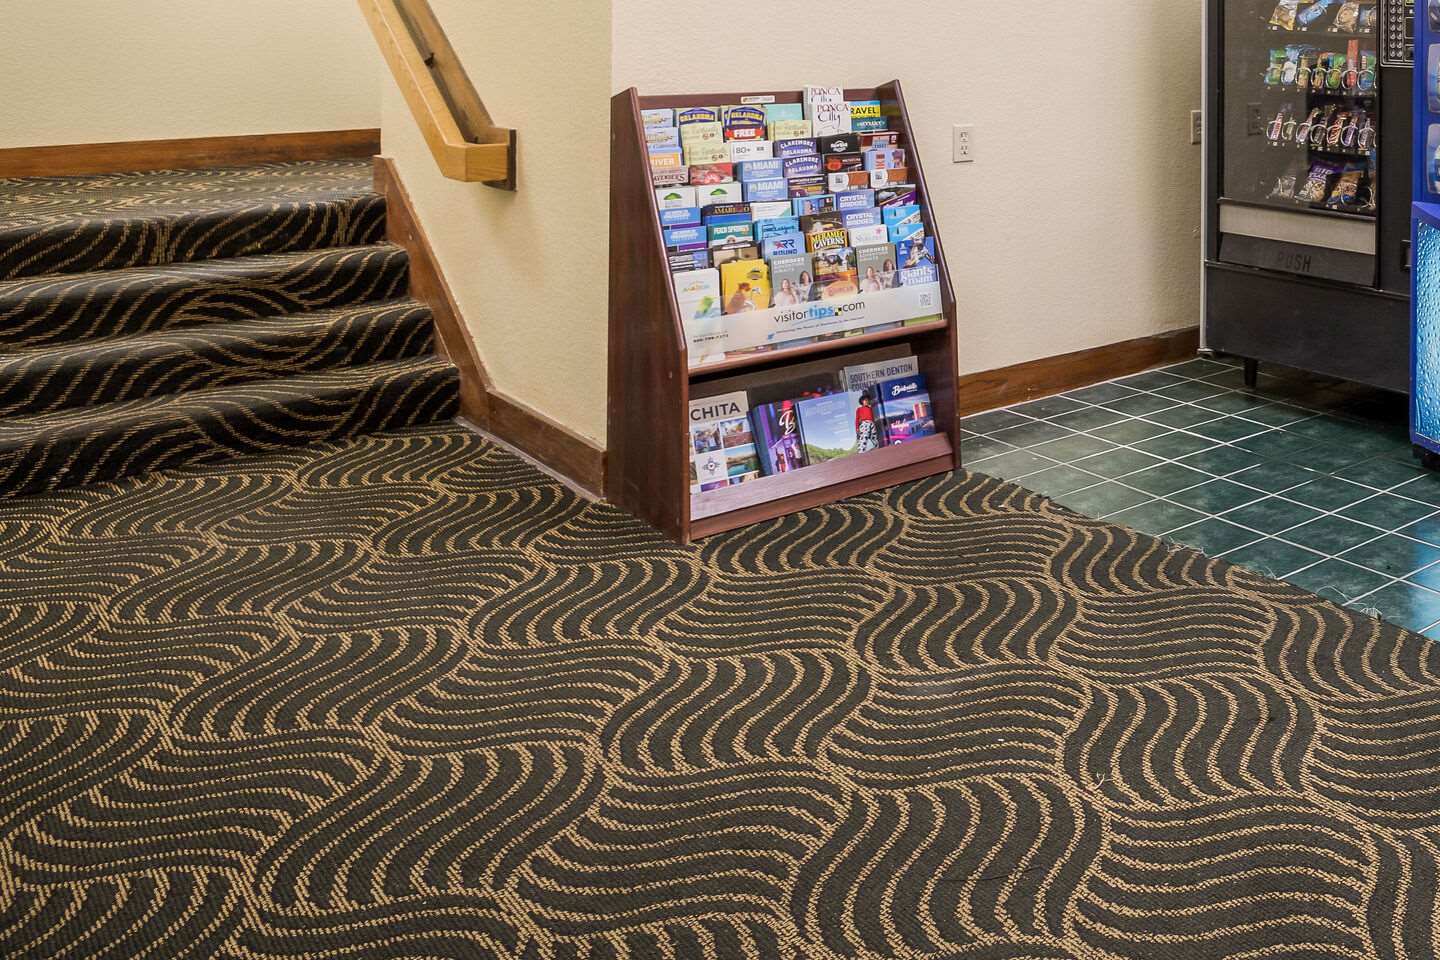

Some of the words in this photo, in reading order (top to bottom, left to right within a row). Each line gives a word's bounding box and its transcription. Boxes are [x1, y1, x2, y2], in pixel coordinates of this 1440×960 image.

[1278, 253, 1312, 273] PUSH
[850, 368, 885, 381] SOUTHERN
[887, 363, 913, 376] DENTON
